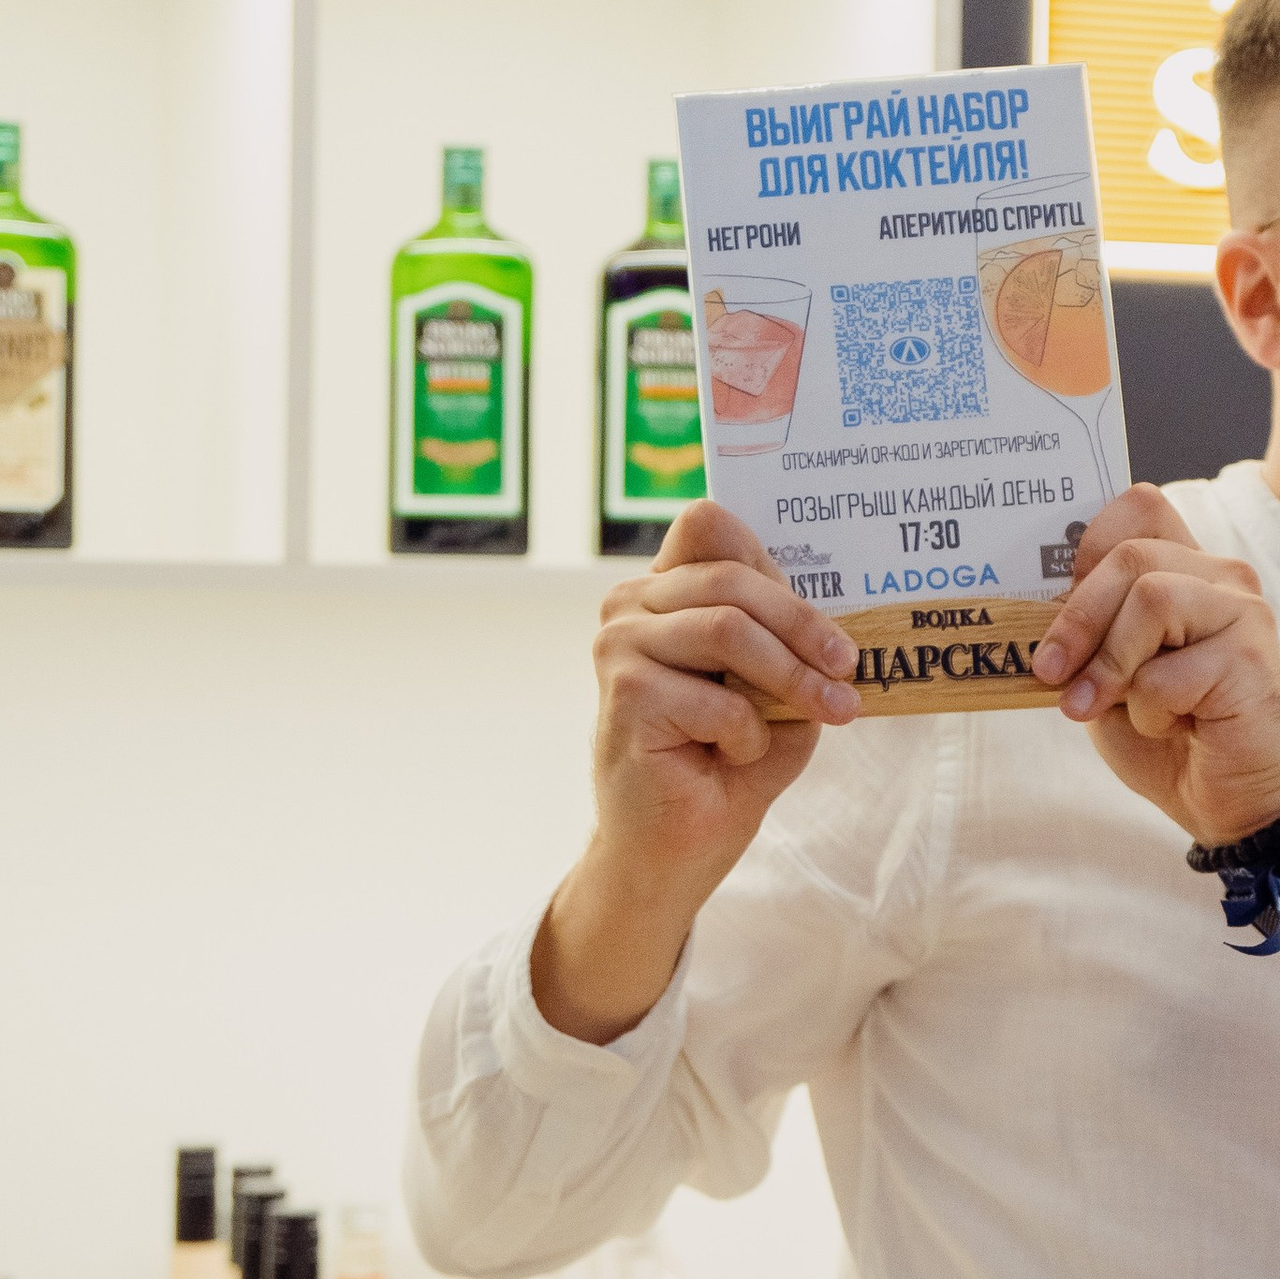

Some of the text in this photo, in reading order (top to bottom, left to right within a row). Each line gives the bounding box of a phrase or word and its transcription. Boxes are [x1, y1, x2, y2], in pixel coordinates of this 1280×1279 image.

[745, 88, 1030, 148] ВЫИГРАЙ НАБОР
[758, 135, 1029, 198] ДЛЯ КОКТЕЙЛЯ!
[707, 221, 801, 253] НЕГРОНИ
[879, 201, 1086, 241] АПЕРИТИВО СПРИТЦ
[781, 432, 1061, 471] ОТСКАНИРУЙ QR-КОД И ЗАРЕГИСТРИРУЙСЯ
[777, 477, 1075, 524] РОЗЫГРЫШ КАЖДЫЙ ДЕНЬ В
[900, 519, 961, 553] 17:30
[789, 571, 845, 599] ISTER
[864, 563, 1000, 597] LADOGA
[911, 608, 993, 630] ВОДКА
